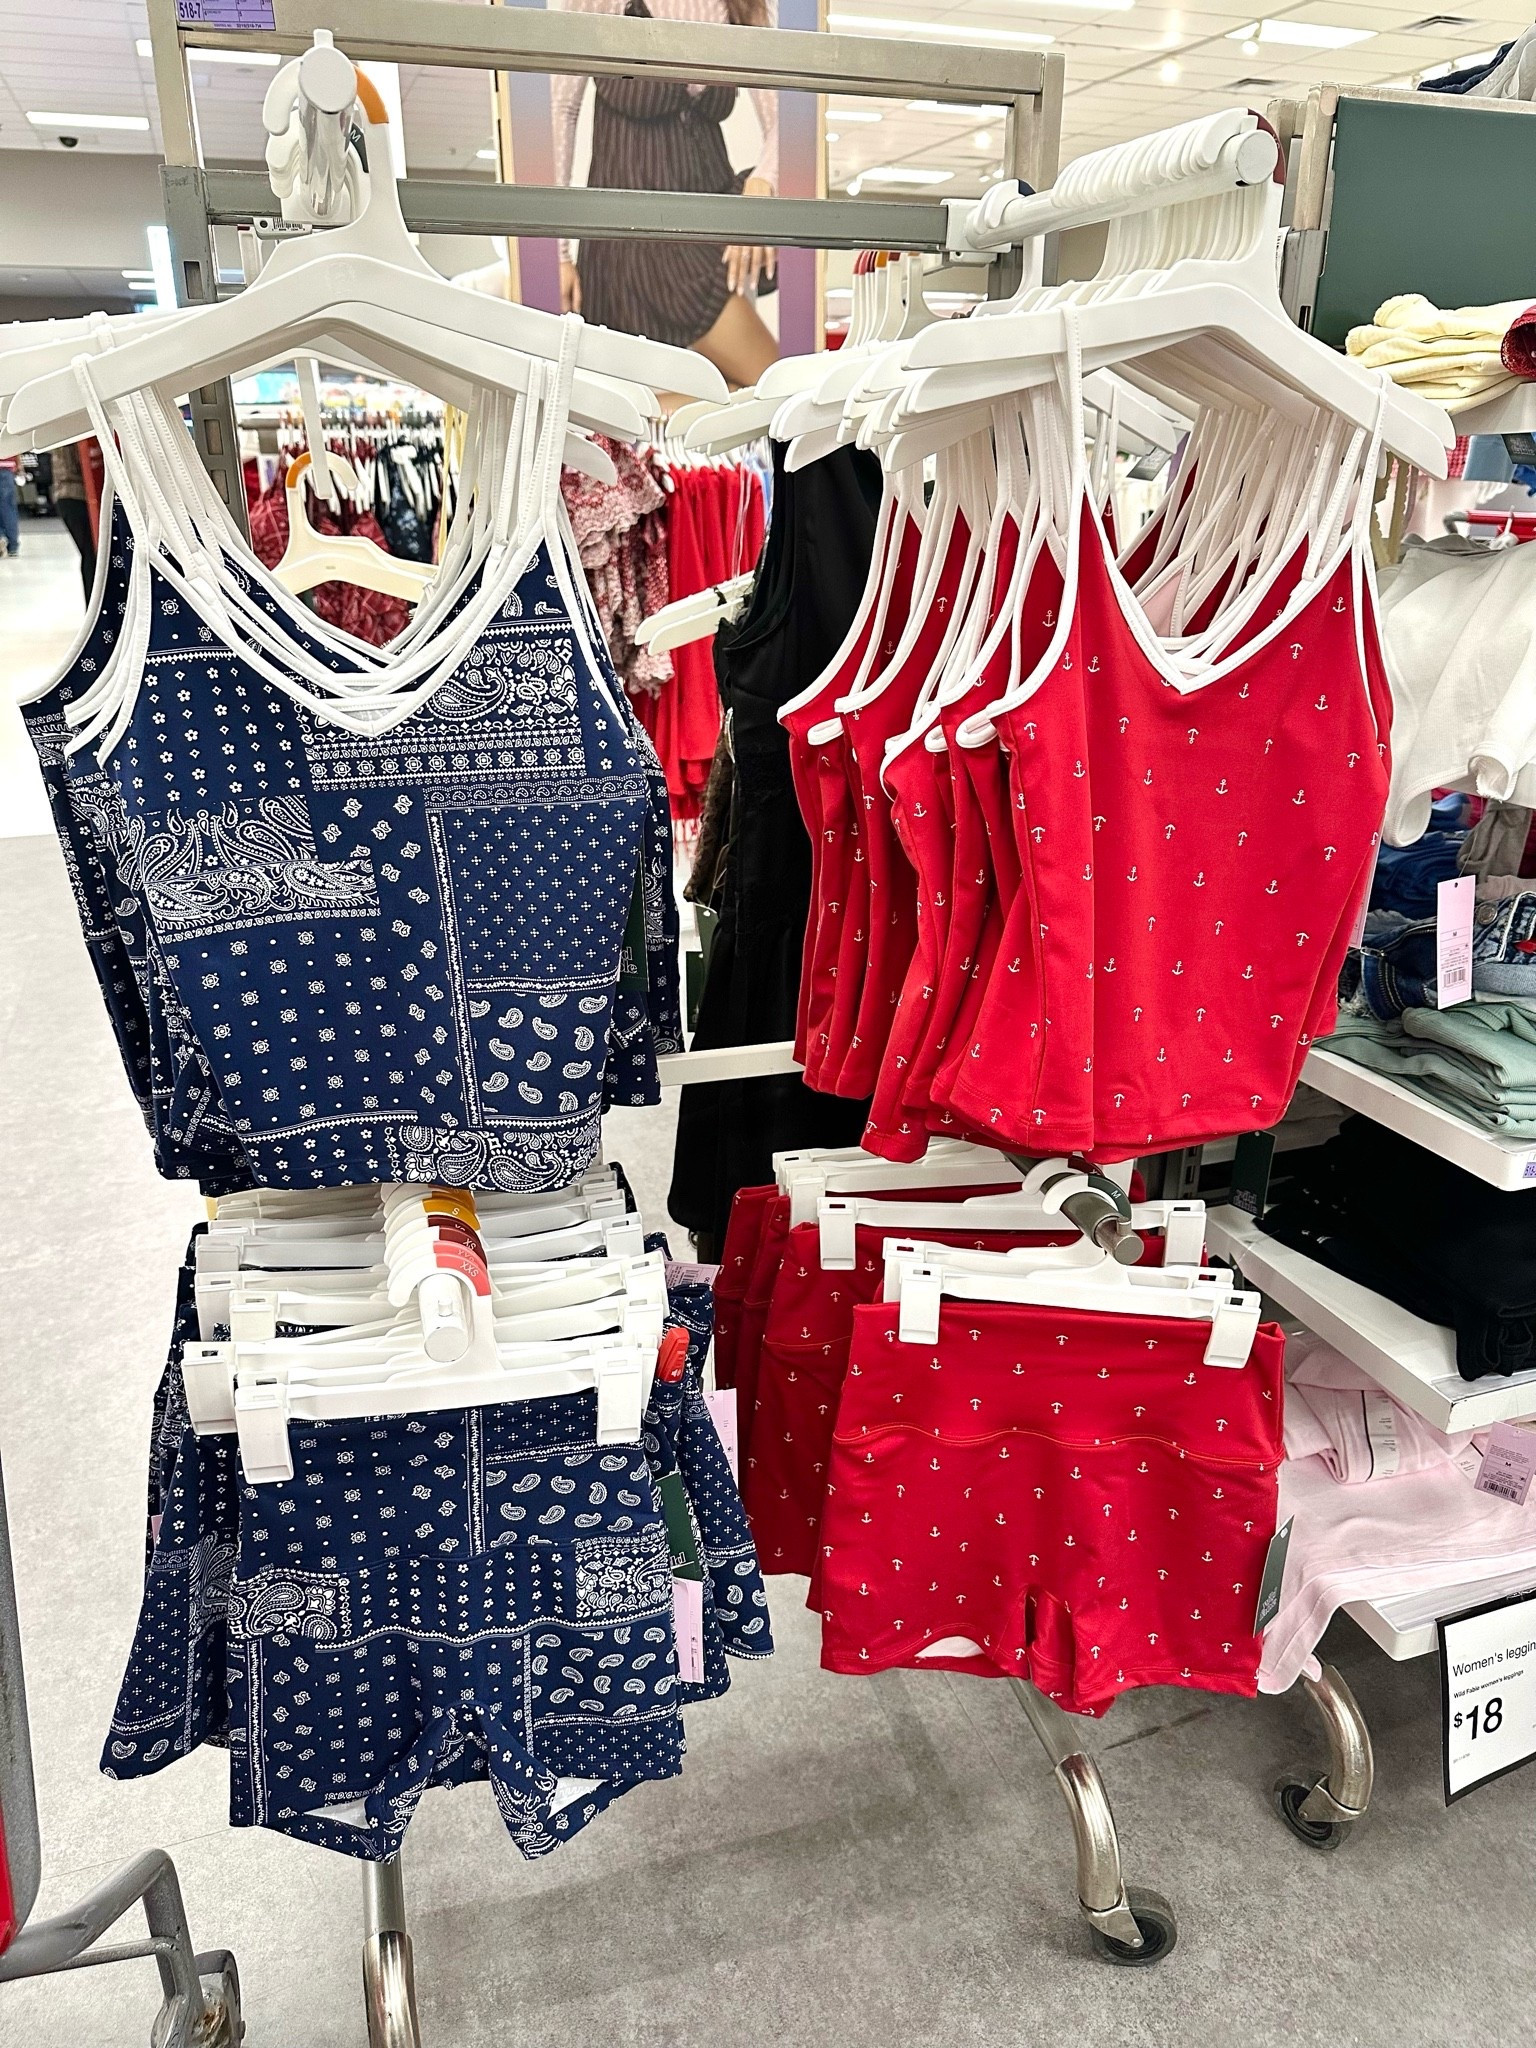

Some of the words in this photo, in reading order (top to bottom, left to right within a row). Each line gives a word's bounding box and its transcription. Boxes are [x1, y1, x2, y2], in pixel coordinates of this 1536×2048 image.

[179, 2, 201, 19] 518-7
[349, 129, 361, 143] M
[1110, 1190, 1122, 1199] M
[451, 1207, 460, 1216] S
[462, 1238, 476, 1251] XS
[460, 1260, 479, 1277] XXS
[1452, 1652, 1503, 1677] Women's
[1453, 1689, 1466, 1699] Wild
[1466, 1685, 1480, 1695] Fable
[1453, 1697, 1503, 1740] $18
